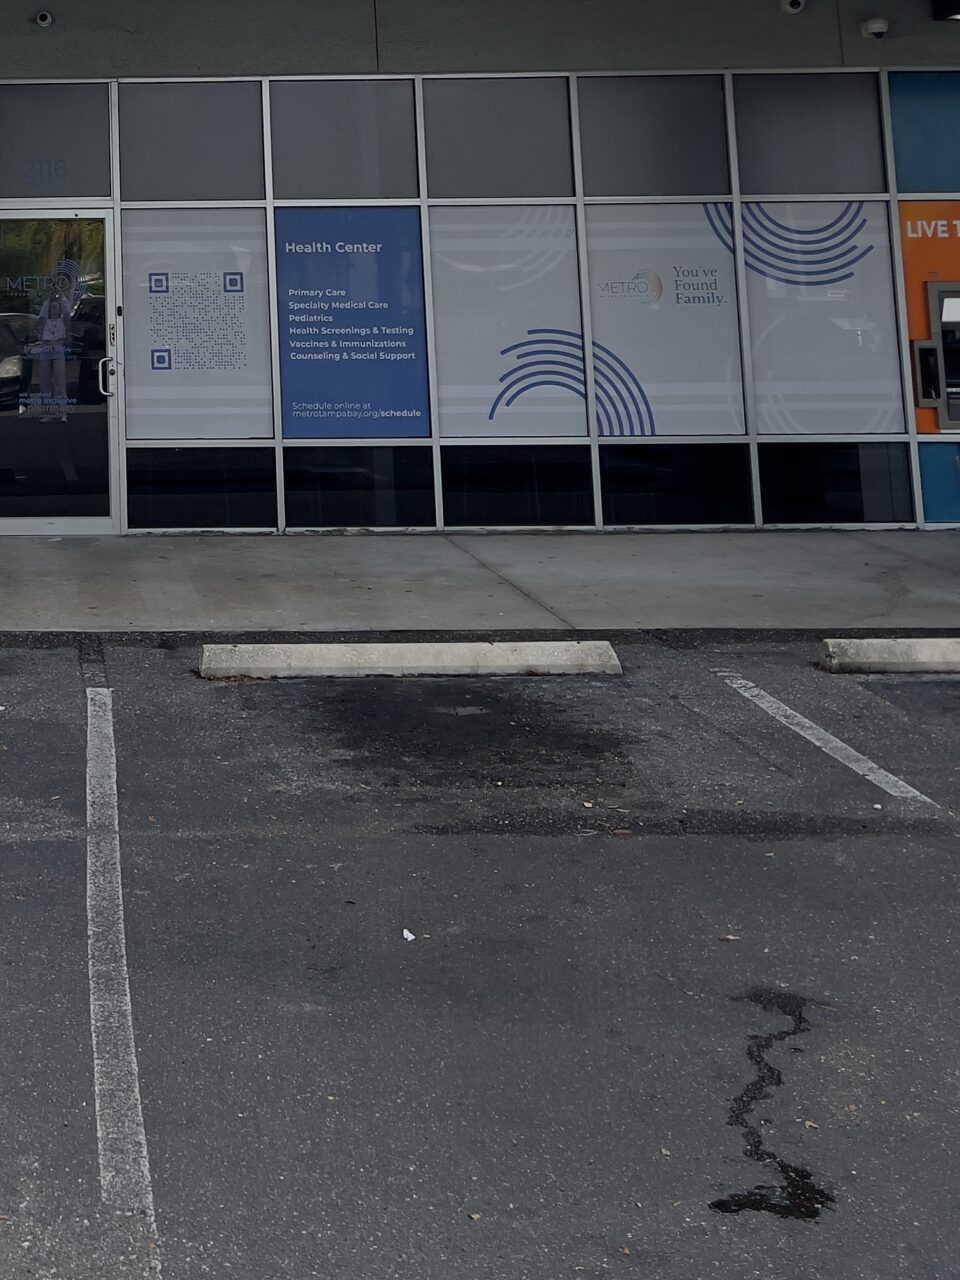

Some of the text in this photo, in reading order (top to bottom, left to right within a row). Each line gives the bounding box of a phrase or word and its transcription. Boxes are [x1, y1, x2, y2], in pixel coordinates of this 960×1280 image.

[23, 159, 68, 177] 2116
[906, 220, 949, 238] LIVE
[285, 242, 382, 253] Health Center
[673, 266, 718, 278] You've
[6, 276, 69, 291] METRO
[598, 282, 649, 294] METRO
[675, 279, 718, 291] Found
[288, 289, 346, 297] Primary Care
[675, 292, 727, 307] Family.
[288, 301, 388, 310] Specialty Medical Care
[289, 314, 334, 322] Pediatrics
[289, 326, 319, 335] Health
[321, 326, 371, 336] Screenings
[381, 326, 414, 336] Testing
[289, 339, 406, 348] Vaccines & Immunizations
[290, 351, 416, 361] Counseling & Social Support
[292, 402, 371, 410] Schedule online at
[292, 408, 421, 418] metrotampabay.org/schedule
